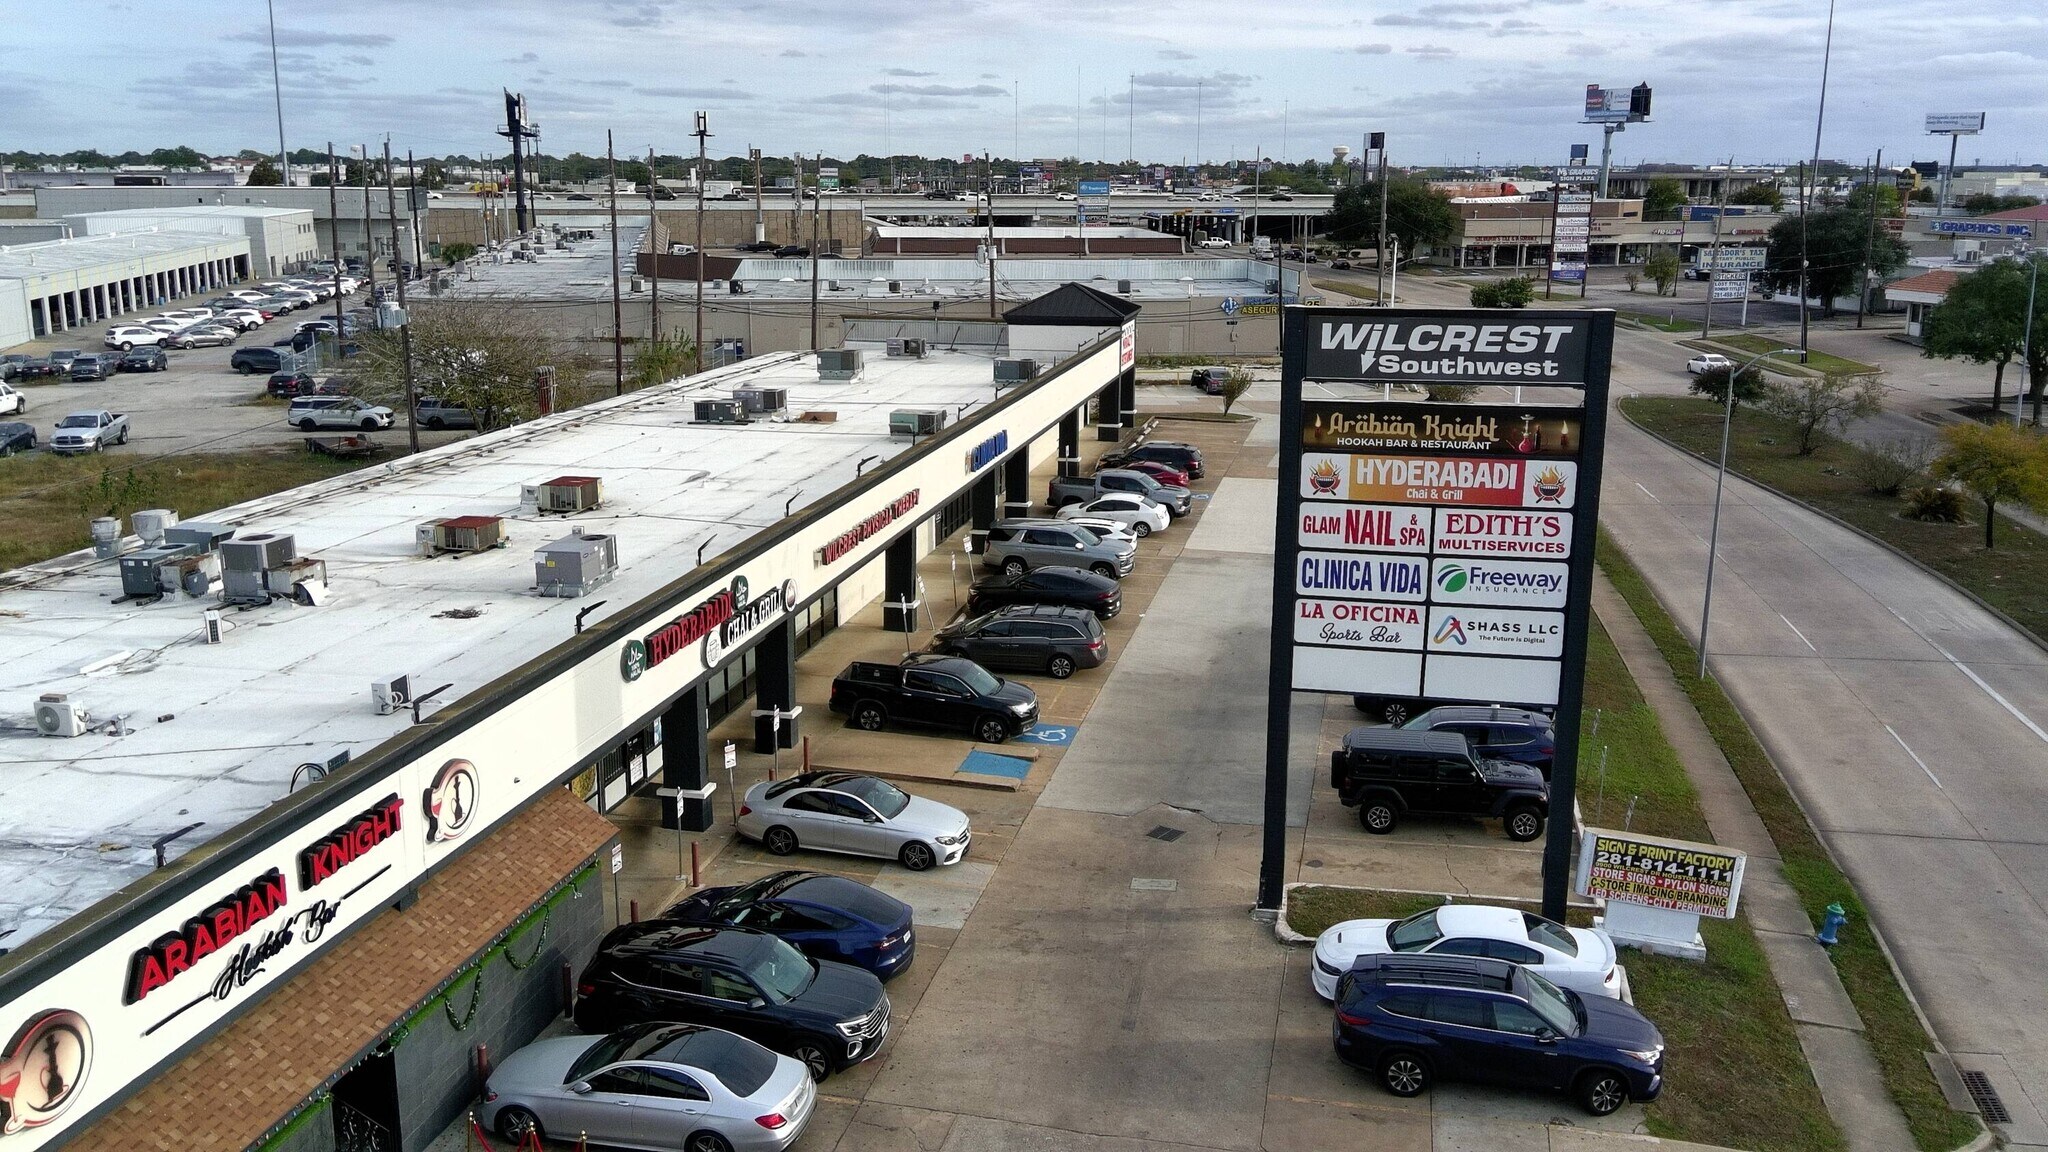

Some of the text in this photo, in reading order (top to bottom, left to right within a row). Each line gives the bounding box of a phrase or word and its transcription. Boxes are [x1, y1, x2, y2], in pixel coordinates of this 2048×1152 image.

[1941, 221, 2001, 234] GRAPHICS
[1378, 353, 1559, 377] Southwest
[1422, 414, 1500, 443] Knight
[1337, 437, 1491, 450] HOOKAH BAR & RESTAURANT
[1356, 458, 1517, 489] HYDERABADI
[1406, 487, 1463, 500] Chai & Grill
[822, 488, 920, 565] WILCREST PHYSICAL THERAPY
[1303, 509, 1418, 546] GLAM NAIL &
[1400, 527, 1425, 547] SPA
[1445, 513, 1561, 537] EDITH'S
[1438, 538, 1565, 553] MULTISERVICES
[1301, 557, 1422, 595] CLINICA VIDA
[1469, 566, 1562, 592] Freeway
[1469, 585, 1547, 595] INSURANCE
[728, 610, 750, 646] CHAI
[751, 606, 758, 630] &
[759, 589, 783, 624] GRILL
[1301, 602, 1420, 624] LA OFICINA
[651, 591, 734, 667] HYDERABADI
[1319, 623, 1402, 644] Sports Bar
[1467, 621, 1559, 635] SHASS LLC
[313, 798, 404, 885] KNIGHT
[1597, 839, 1733, 870] SIGN & PRINT FACTORY
[1597, 852, 1733, 882] 281-814-1111
[1613, 864, 1648, 874] WILCREST
[1662, 872, 1697, 881] HOUSTON
[1590, 878, 1631, 891] C-STORE
[1593, 867, 1729, 897] STORE SIGNS PYLON SIGNS
[1590, 888, 1607, 898] LED
[1609, 890, 1649, 905] SCREENS
[1653, 897, 1676, 908] CITY
[138, 874, 288, 1000] ARABIAN
